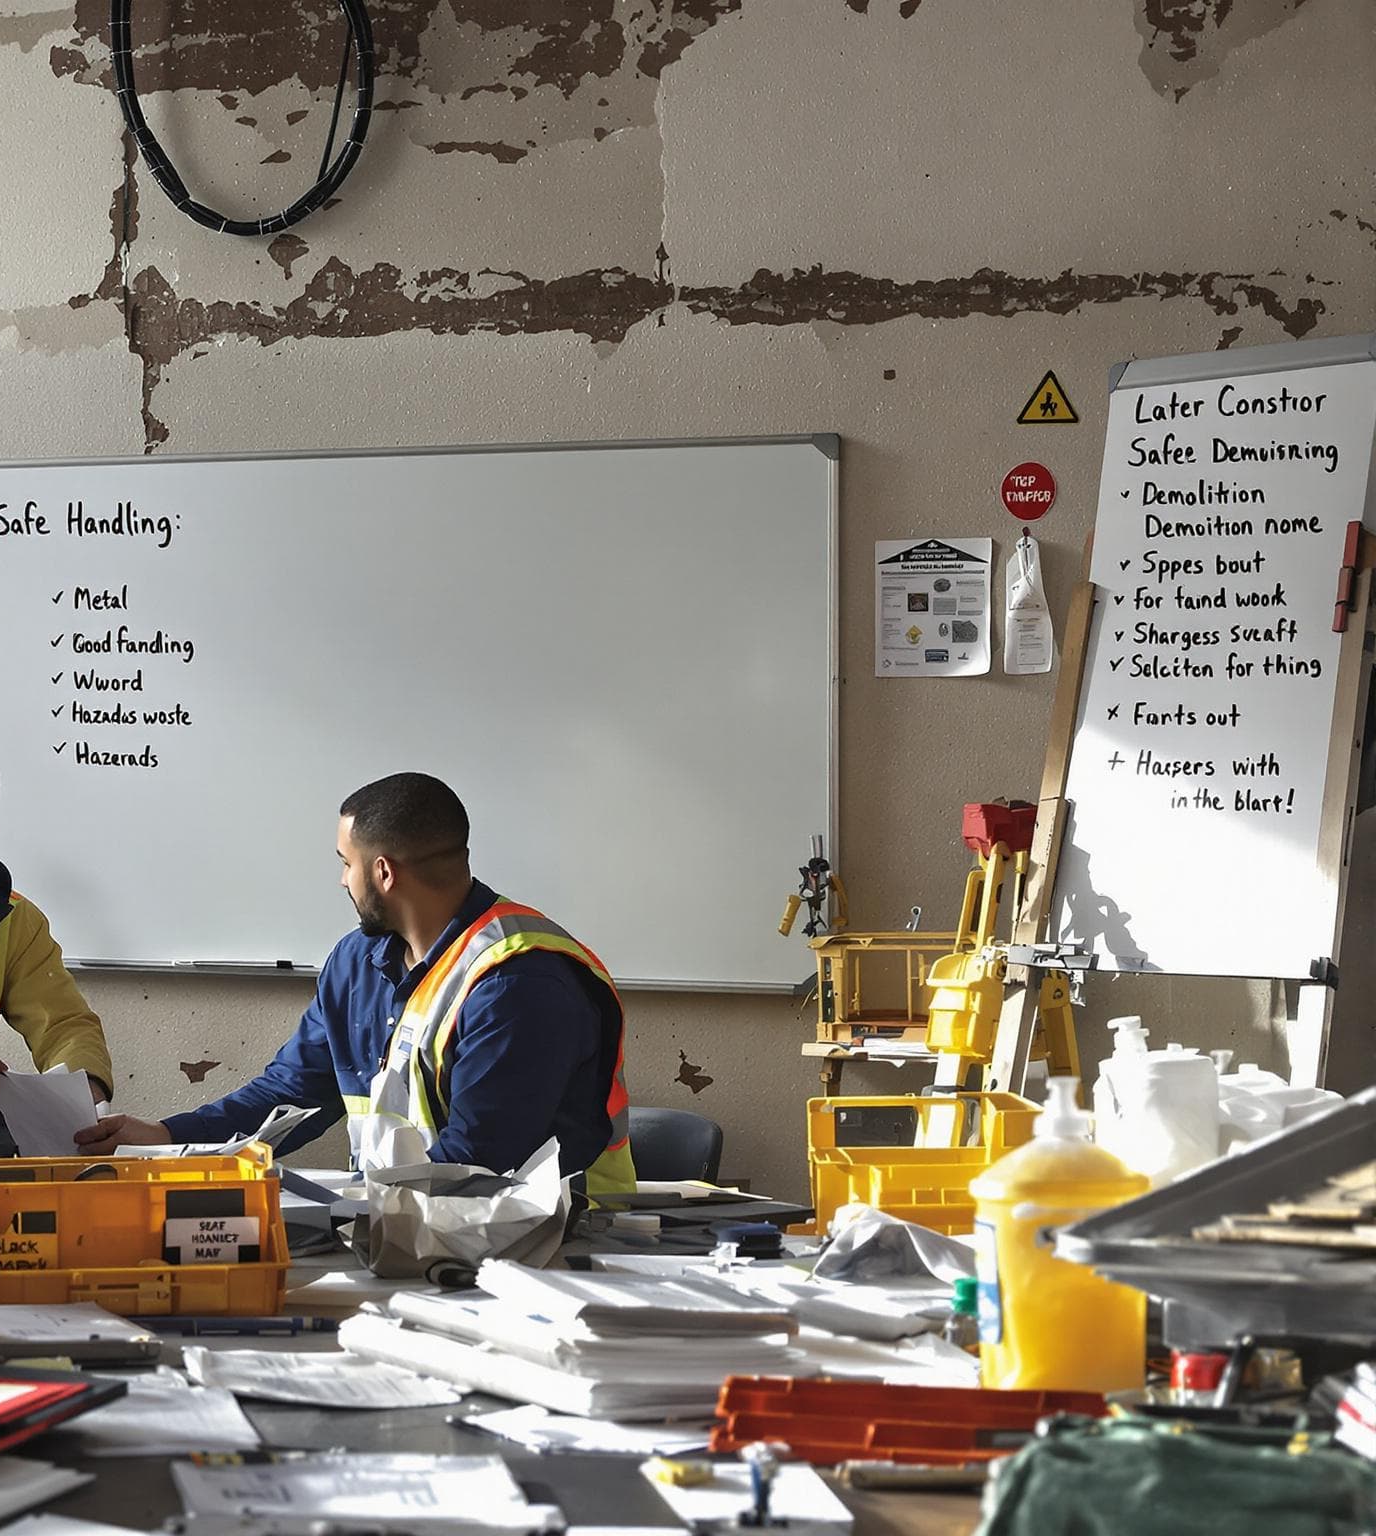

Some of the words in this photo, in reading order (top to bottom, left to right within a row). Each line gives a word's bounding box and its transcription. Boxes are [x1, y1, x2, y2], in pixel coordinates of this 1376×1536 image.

[1134, 391, 1205, 424] Later
[67, 501, 181, 549] Handling:
[1145, 514, 1253, 538] Demoition
[1264, 516, 1323, 535] nome
[1142, 550, 1204, 584] Sppes
[1215, 550, 1266, 575] bout
[74, 584, 128, 611] Metal
[72, 630, 112, 654] Good
[1225, 652, 1254, 680] for
[1262, 653, 1322, 679] thing
[73, 668, 143, 692] Wword
[1205, 703, 1241, 728] out
[1232, 752, 1280, 777] with
[1171, 790, 1188, 808] in
[1192, 787, 1225, 811] the
